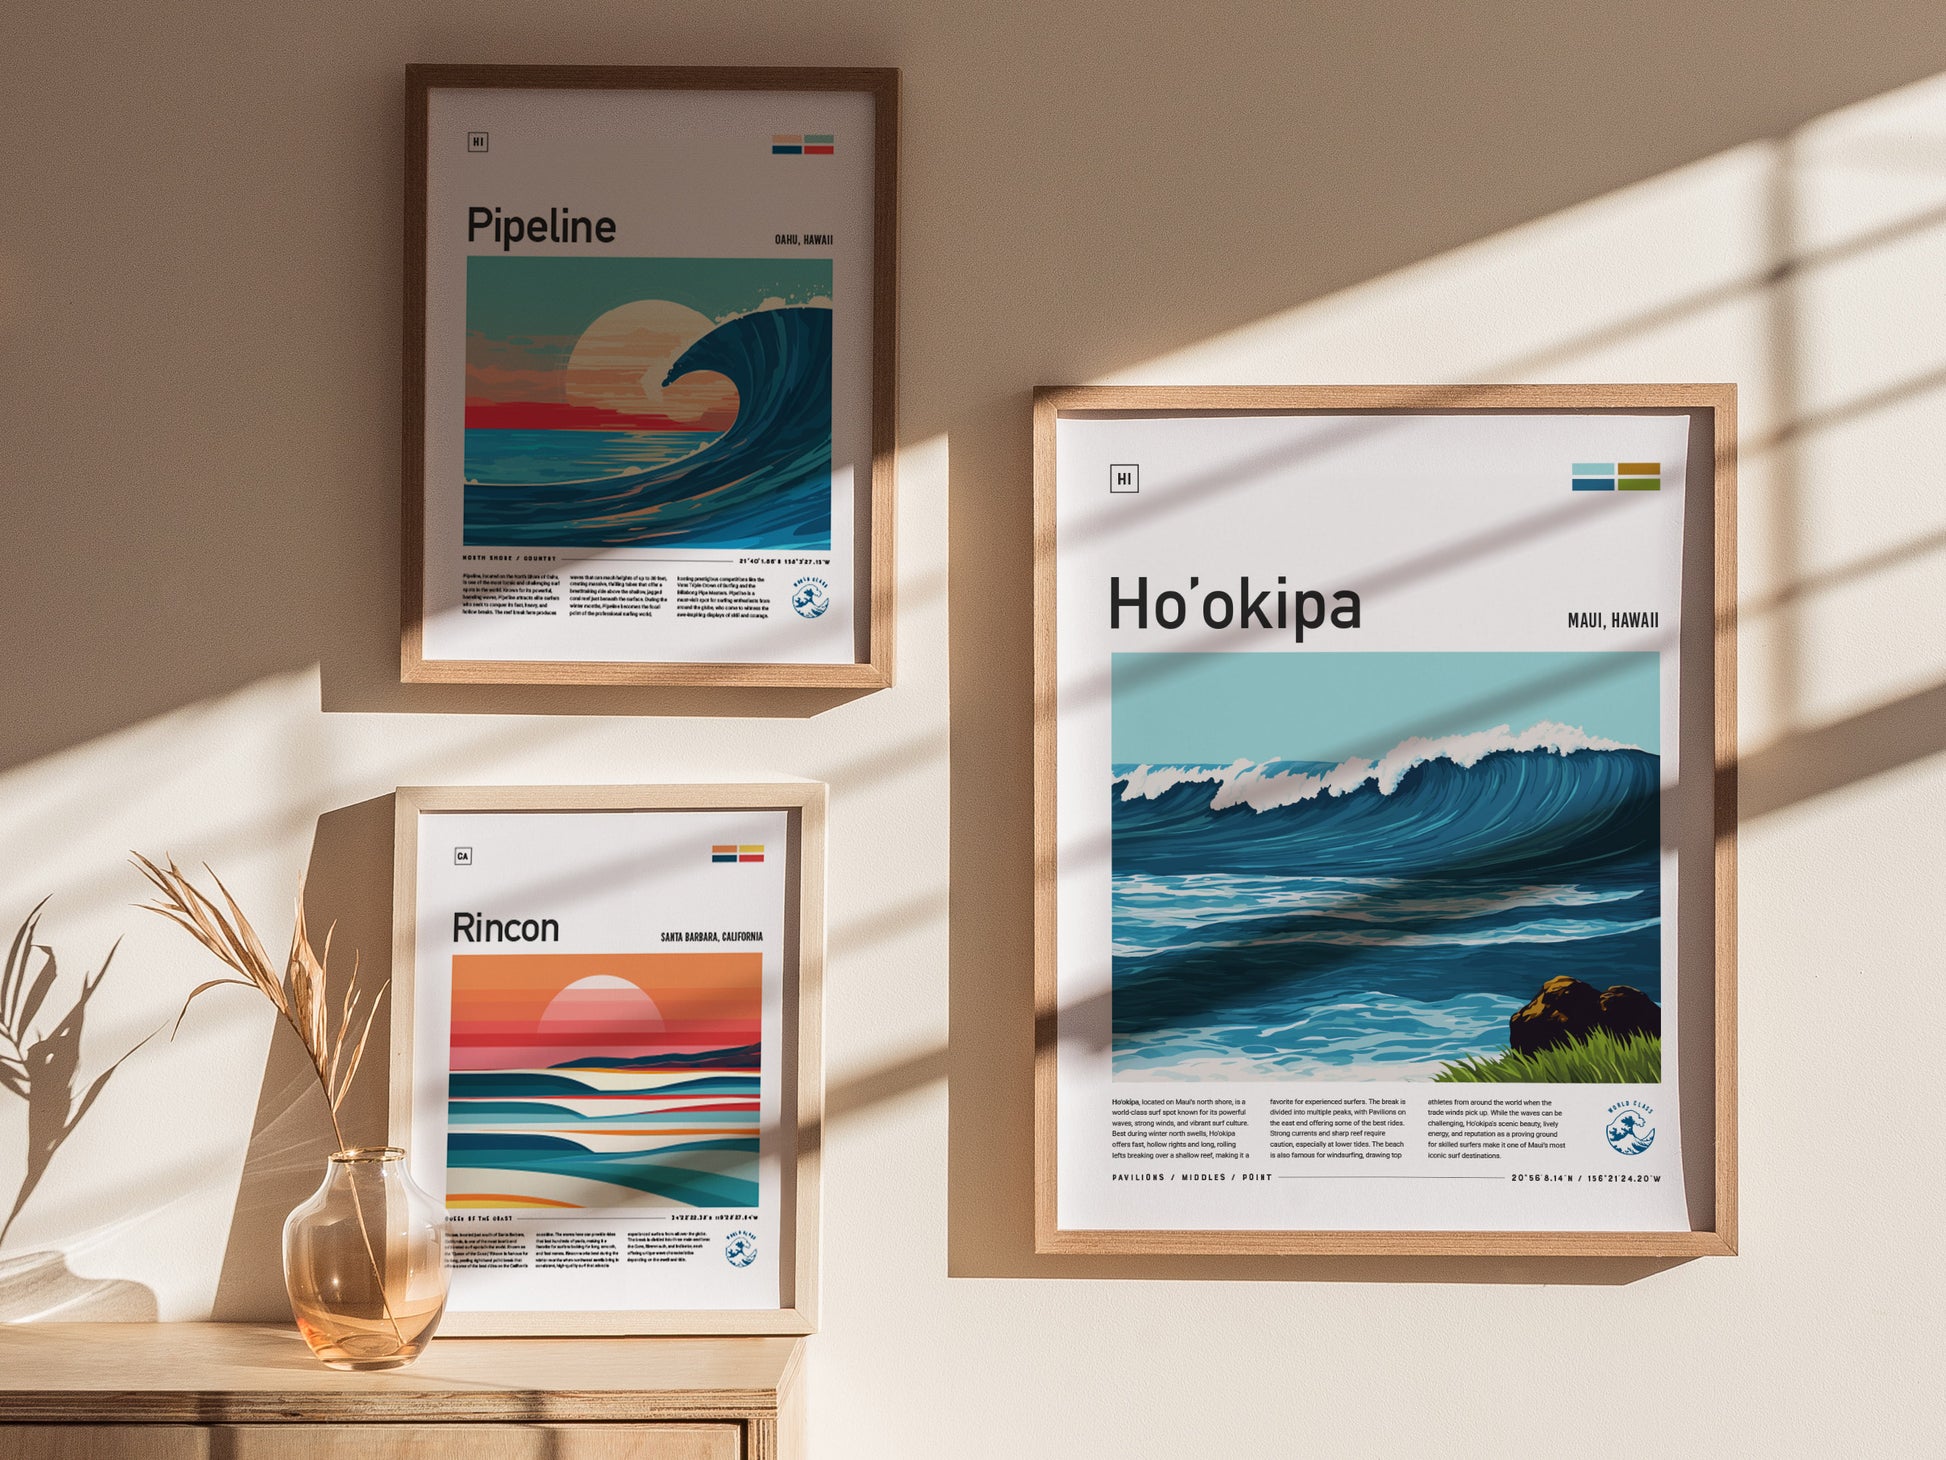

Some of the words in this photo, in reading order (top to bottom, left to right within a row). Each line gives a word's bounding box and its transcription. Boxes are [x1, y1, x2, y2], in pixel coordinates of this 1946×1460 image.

[473, 137, 484, 146] HI
[468, 207, 616, 252] Pipeline
[775, 234, 801, 246] OAHU,
[803, 234, 833, 245] HAWAII
[1117, 472, 1132, 485] HI
[1111, 576, 1360, 643] Ho'okipa
[1568, 612, 1606, 630] MAUI,
[1612, 612, 1658, 628] HAWAII
[457, 852, 469, 861] CA
[453, 912, 559, 942] Rincon
[661, 932, 683, 942] SANTA
[685, 932, 720, 942] BARBARA,
[722, 931, 763, 942] CALIFORNIA
[1304, 1098, 1342, 1106] experienced
[1608, 1100, 1630, 1113] WORLD
[1633, 1100, 1653, 1114] CLASS
[1465, 1109, 1478, 1117] pick
[1428, 1120, 1465, 1128] challenging,
[1127, 1130, 1147, 1138] during
[1270, 1130, 1290, 1138] Strong
[1535, 1131, 1558, 1139] ground
[1132, 1141, 1146, 1149] fast,
[1168, 1141, 1187, 1149] rights
[1201, 1141, 1216, 1149] long,
[1217, 1141, 1236, 1149] rolling
[1295, 1141, 1327, 1149] especially
[1127, 1152, 1154, 1160] breaking
[1112, 1173, 1164, 1181] PAVILIONS
[1182, 1173, 1225, 1181] MIDDLES
[1242, 1173, 1272, 1181] POINT
